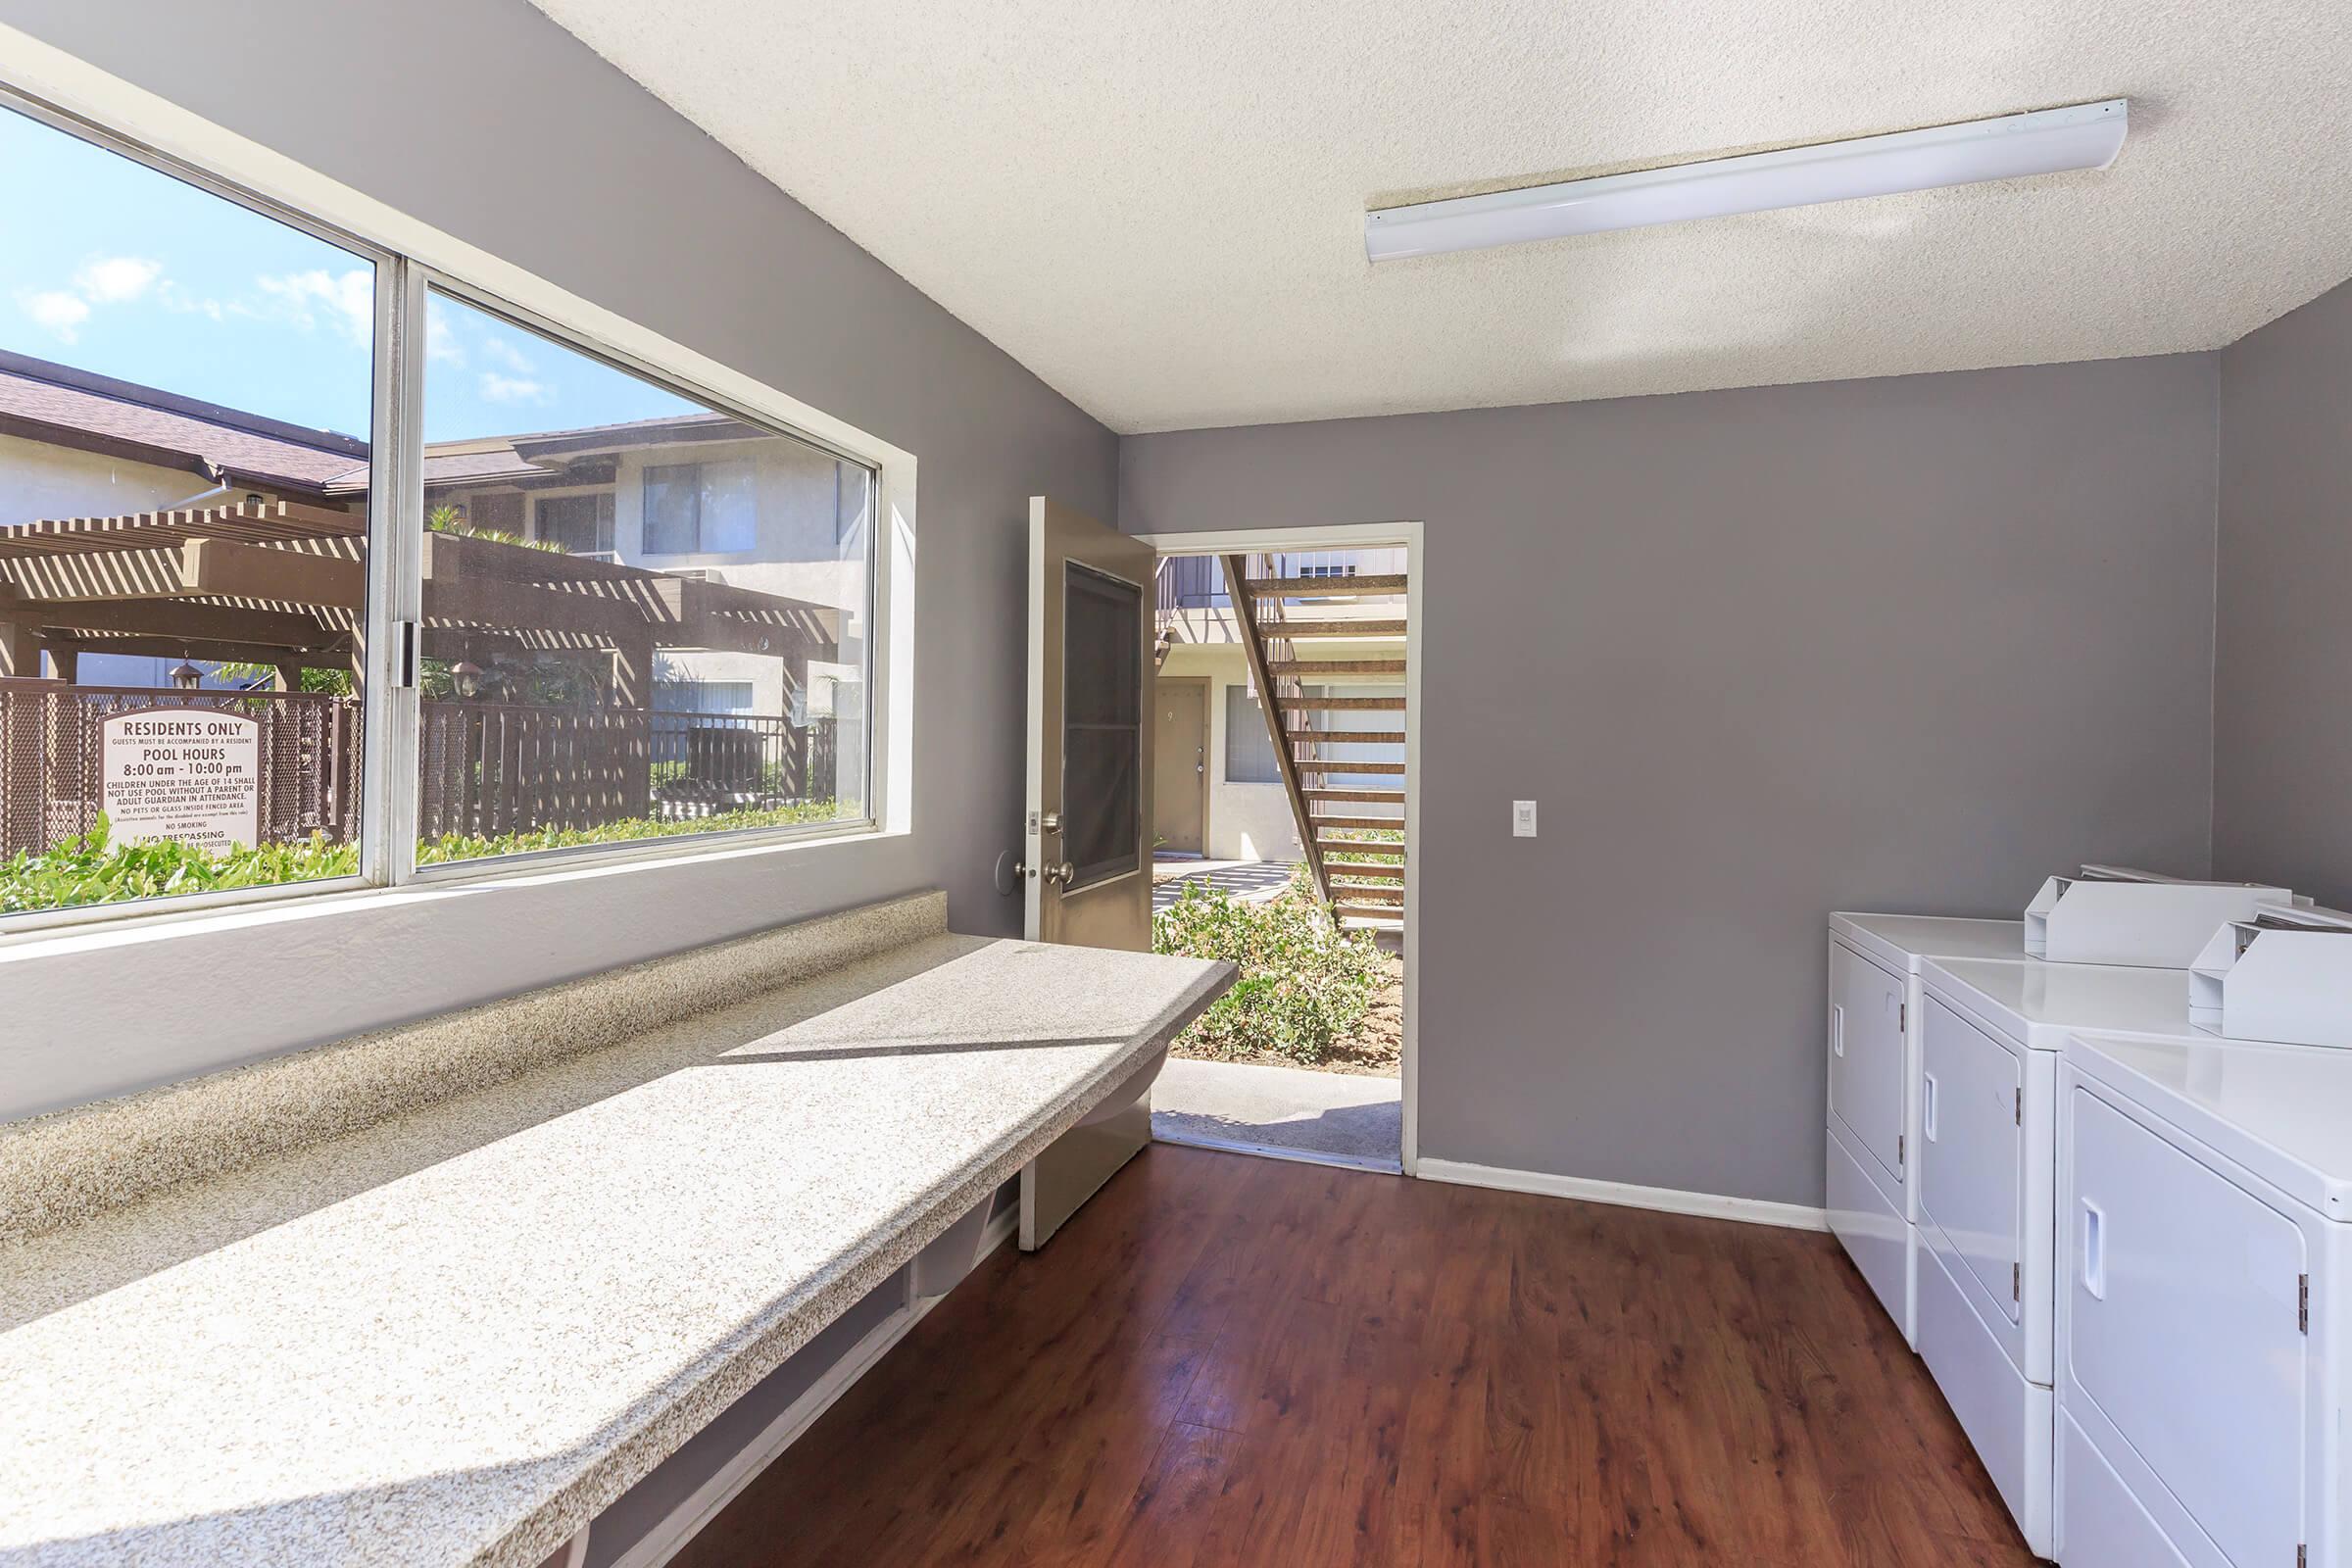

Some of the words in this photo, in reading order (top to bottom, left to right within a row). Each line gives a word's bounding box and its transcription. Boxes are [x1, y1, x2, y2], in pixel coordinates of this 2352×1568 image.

[124, 722, 202, 735] RESIDENTS
[208, 723, 242, 735] ONLY
[143, 749, 177, 760] POOL
[183, 749, 225, 760] HOURS
[124, 764, 153, 776] 8:00
[188, 762, 221, 773] 10:00
[225, 764, 242, 776] pm
[145, 796, 186, 805] GUARDIAN
[199, 793, 247, 802] ATTENDANCE.
